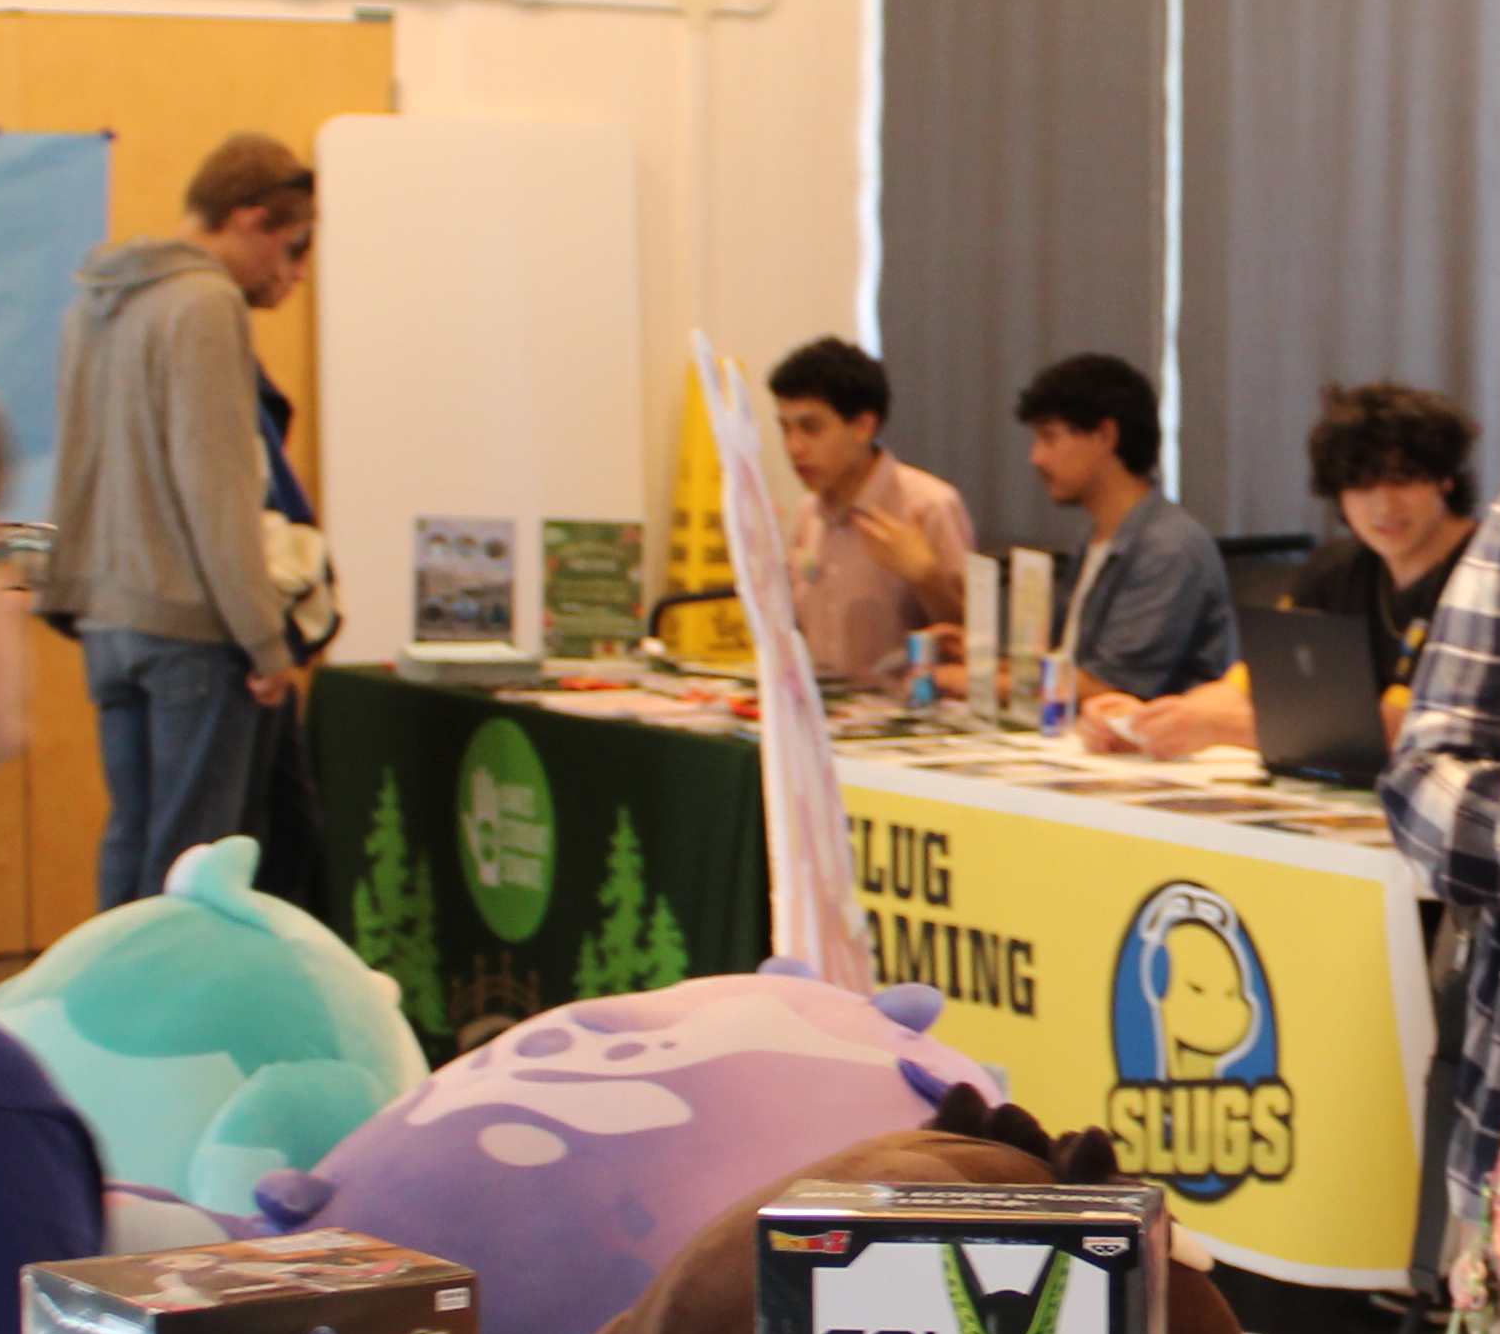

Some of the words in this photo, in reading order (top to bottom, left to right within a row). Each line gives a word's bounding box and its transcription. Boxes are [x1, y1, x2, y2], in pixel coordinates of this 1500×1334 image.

[846, 817, 952, 907] LUG
[868, 911, 1037, 1017] AMING
[1108, 1079, 1294, 1183] SLUGS
